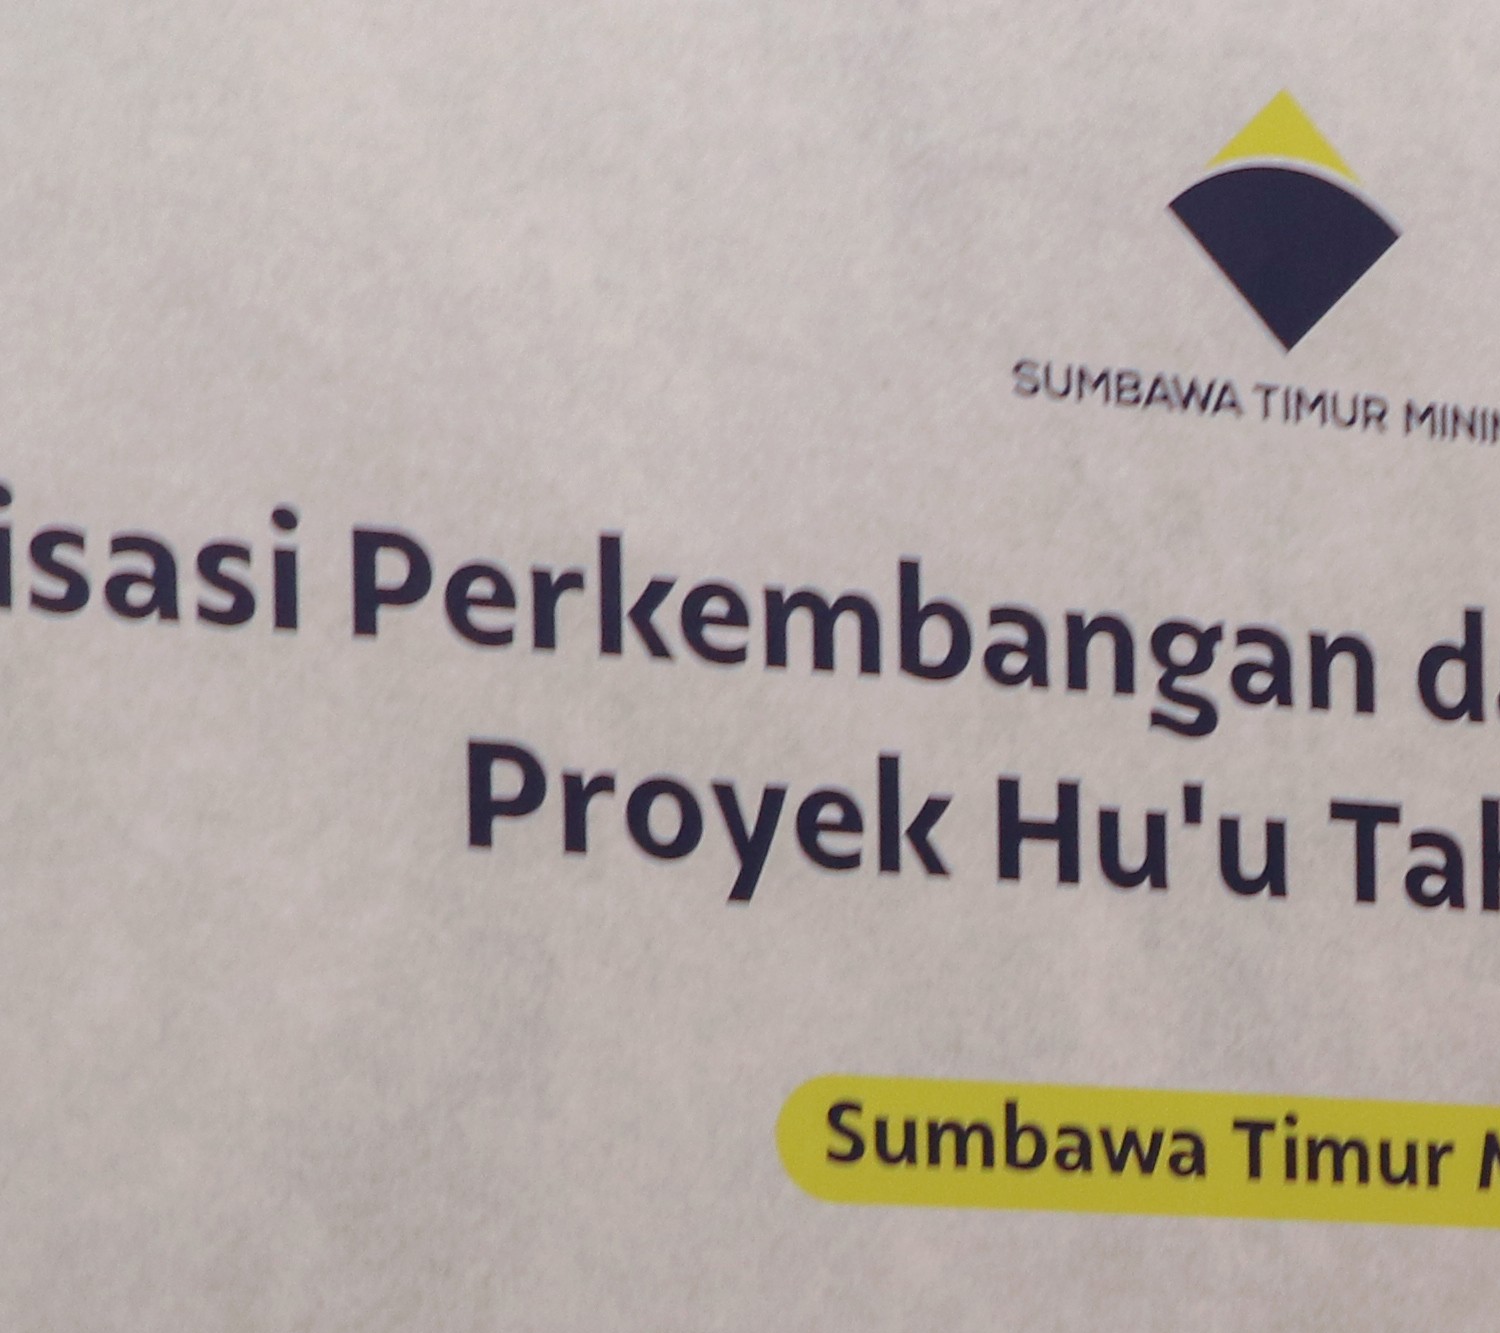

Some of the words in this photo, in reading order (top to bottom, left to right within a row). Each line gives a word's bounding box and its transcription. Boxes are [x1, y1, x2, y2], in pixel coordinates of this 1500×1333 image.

[1012, 358, 1245, 419] SUMBAWA
[1252, 384, 1389, 433] TIMUR
[350, 525, 1376, 738] Perkembangan
[465, 741, 952, 902] Proyek
[996, 776, 1288, 898] Hu'u
[824, 1100, 1206, 1179] Sumbawa
[1231, 1113, 1455, 1189] Timur
